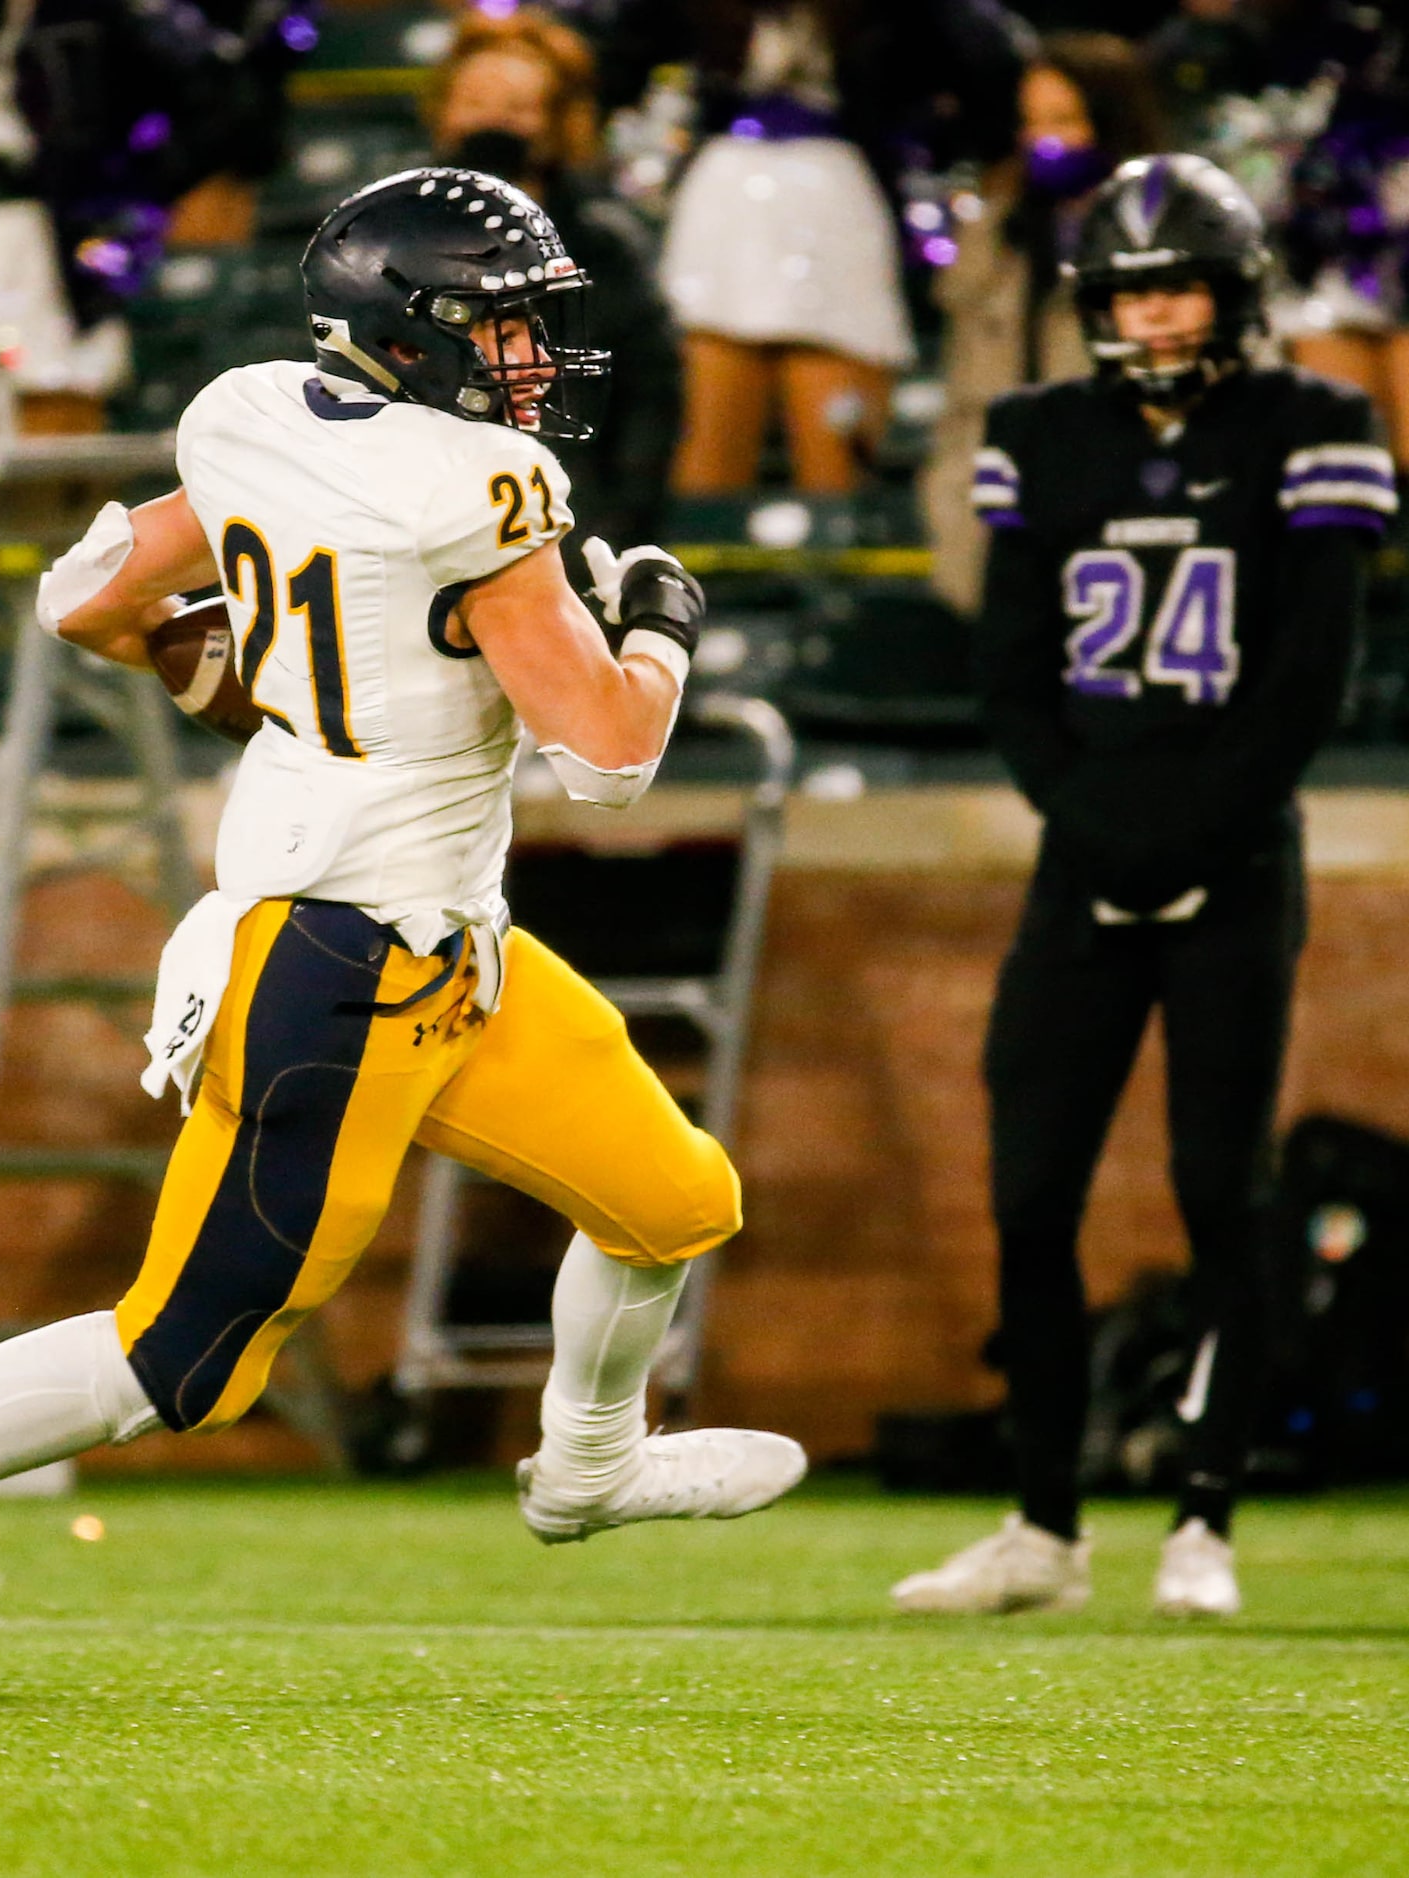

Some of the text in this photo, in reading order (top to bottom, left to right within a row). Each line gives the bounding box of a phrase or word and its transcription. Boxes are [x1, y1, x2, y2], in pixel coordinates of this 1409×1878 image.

[488, 464, 556, 549] 21
[222, 516, 368, 762] 21
[1061, 548, 1240, 705] 24
[178, 992, 204, 1037] 21
